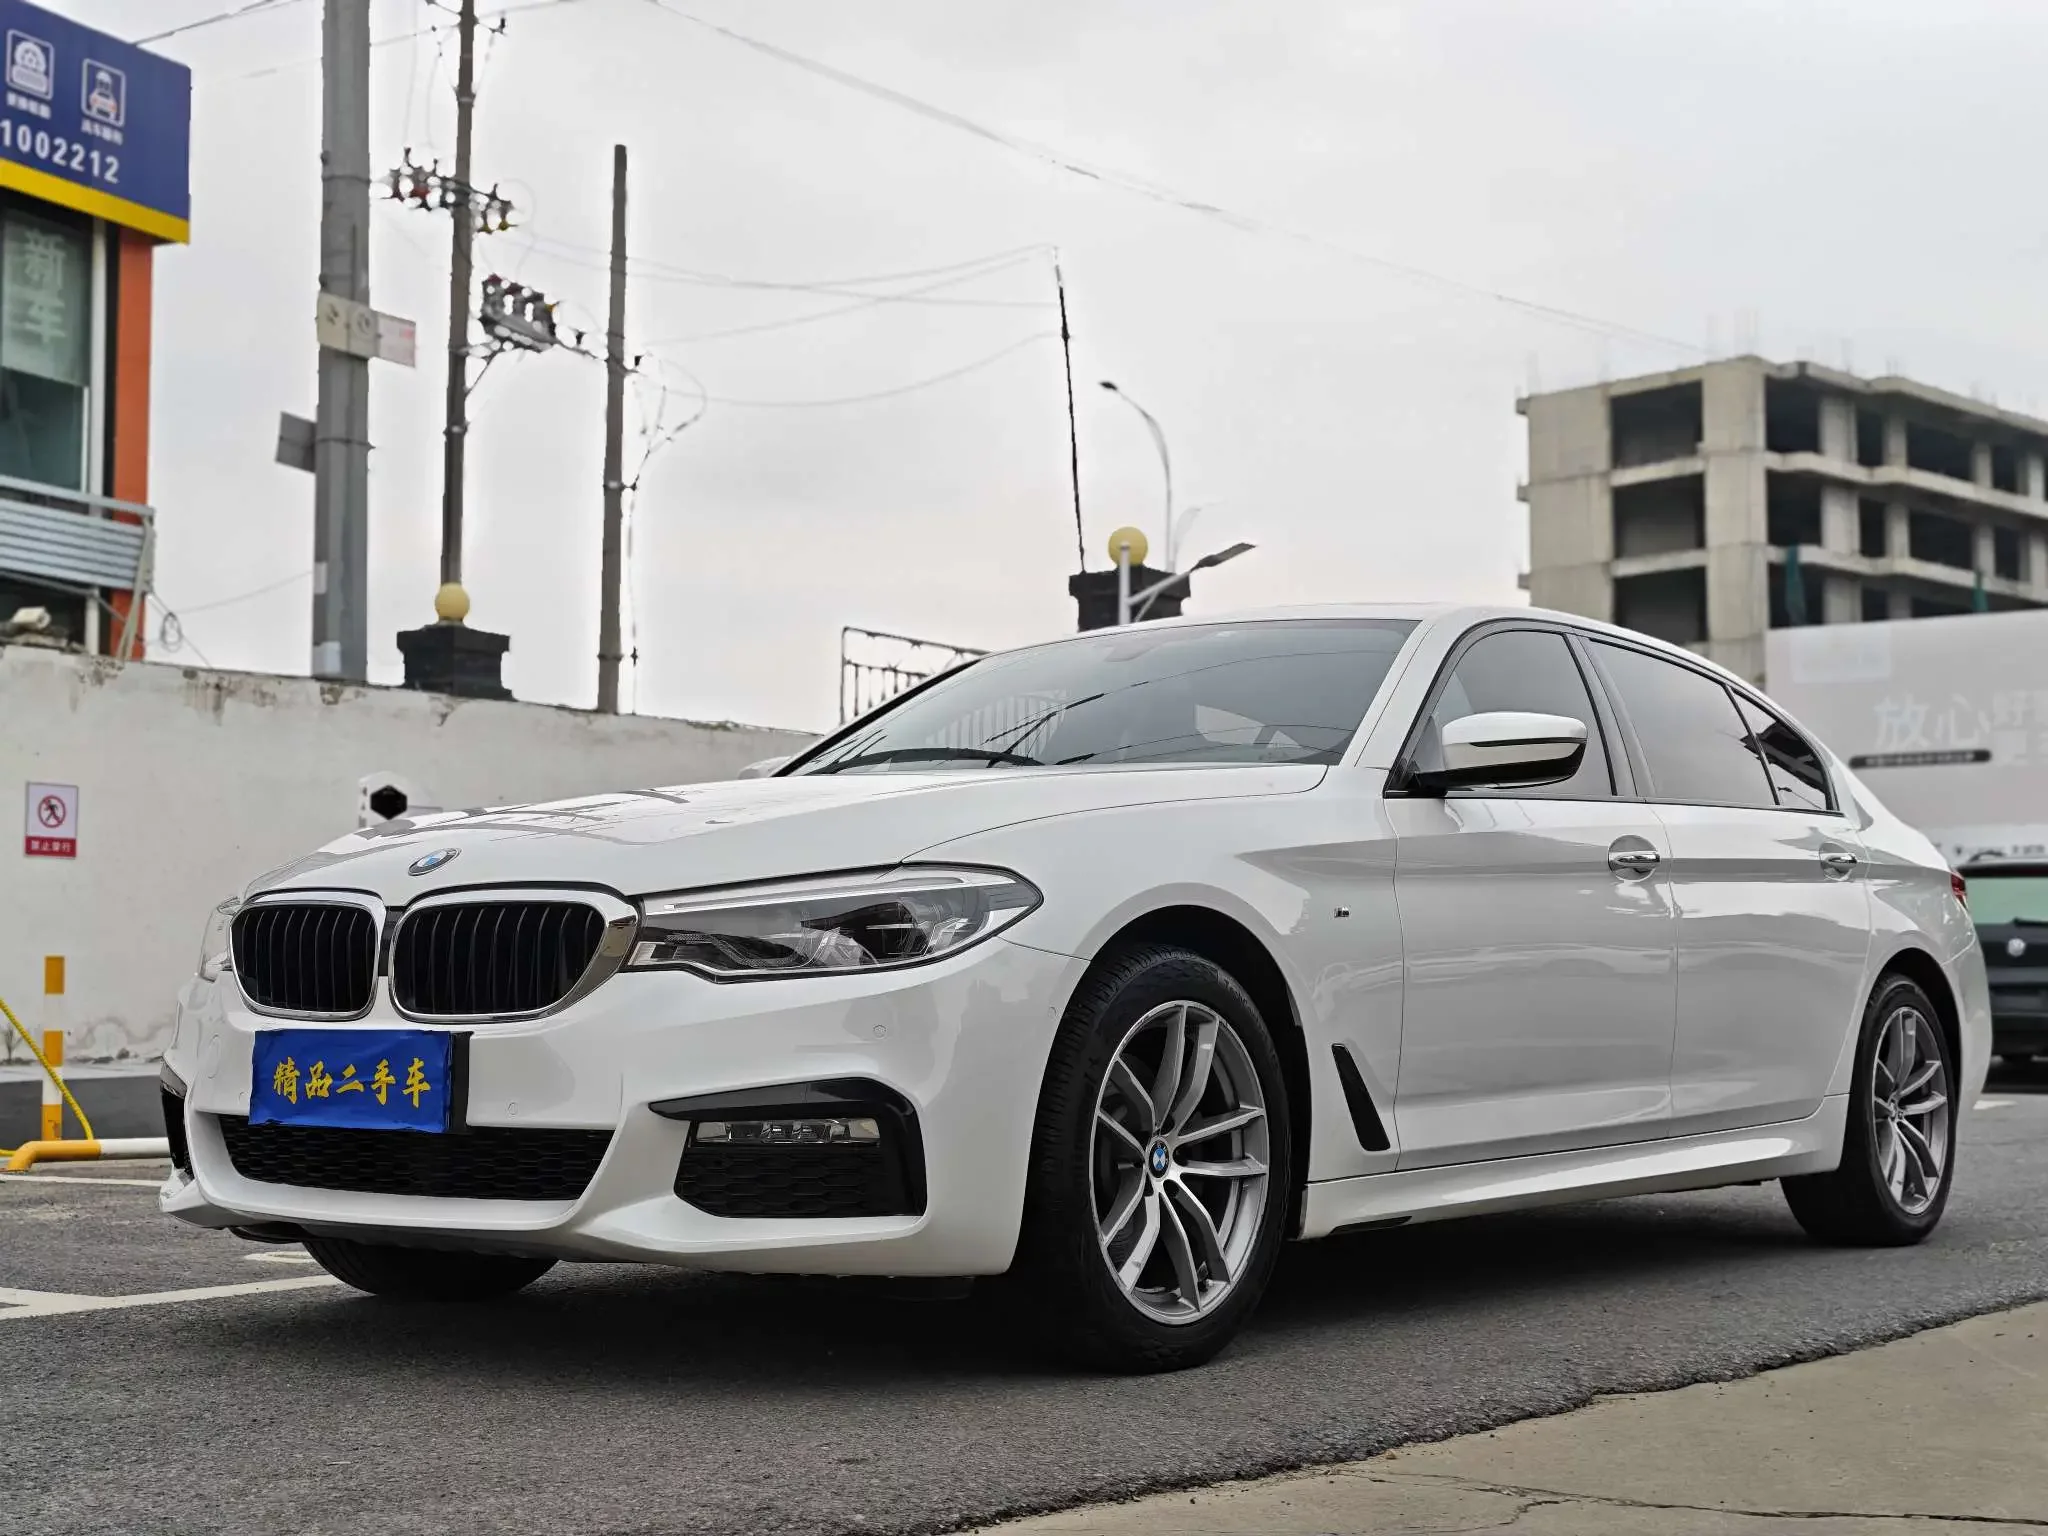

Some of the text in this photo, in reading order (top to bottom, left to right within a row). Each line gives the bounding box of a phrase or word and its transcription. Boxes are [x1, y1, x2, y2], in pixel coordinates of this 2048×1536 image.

[0, 119, 120, 185] 1002212
[1872, 692, 1991, 749] 放心
[273, 1056, 432, 1109] 精品二手车
